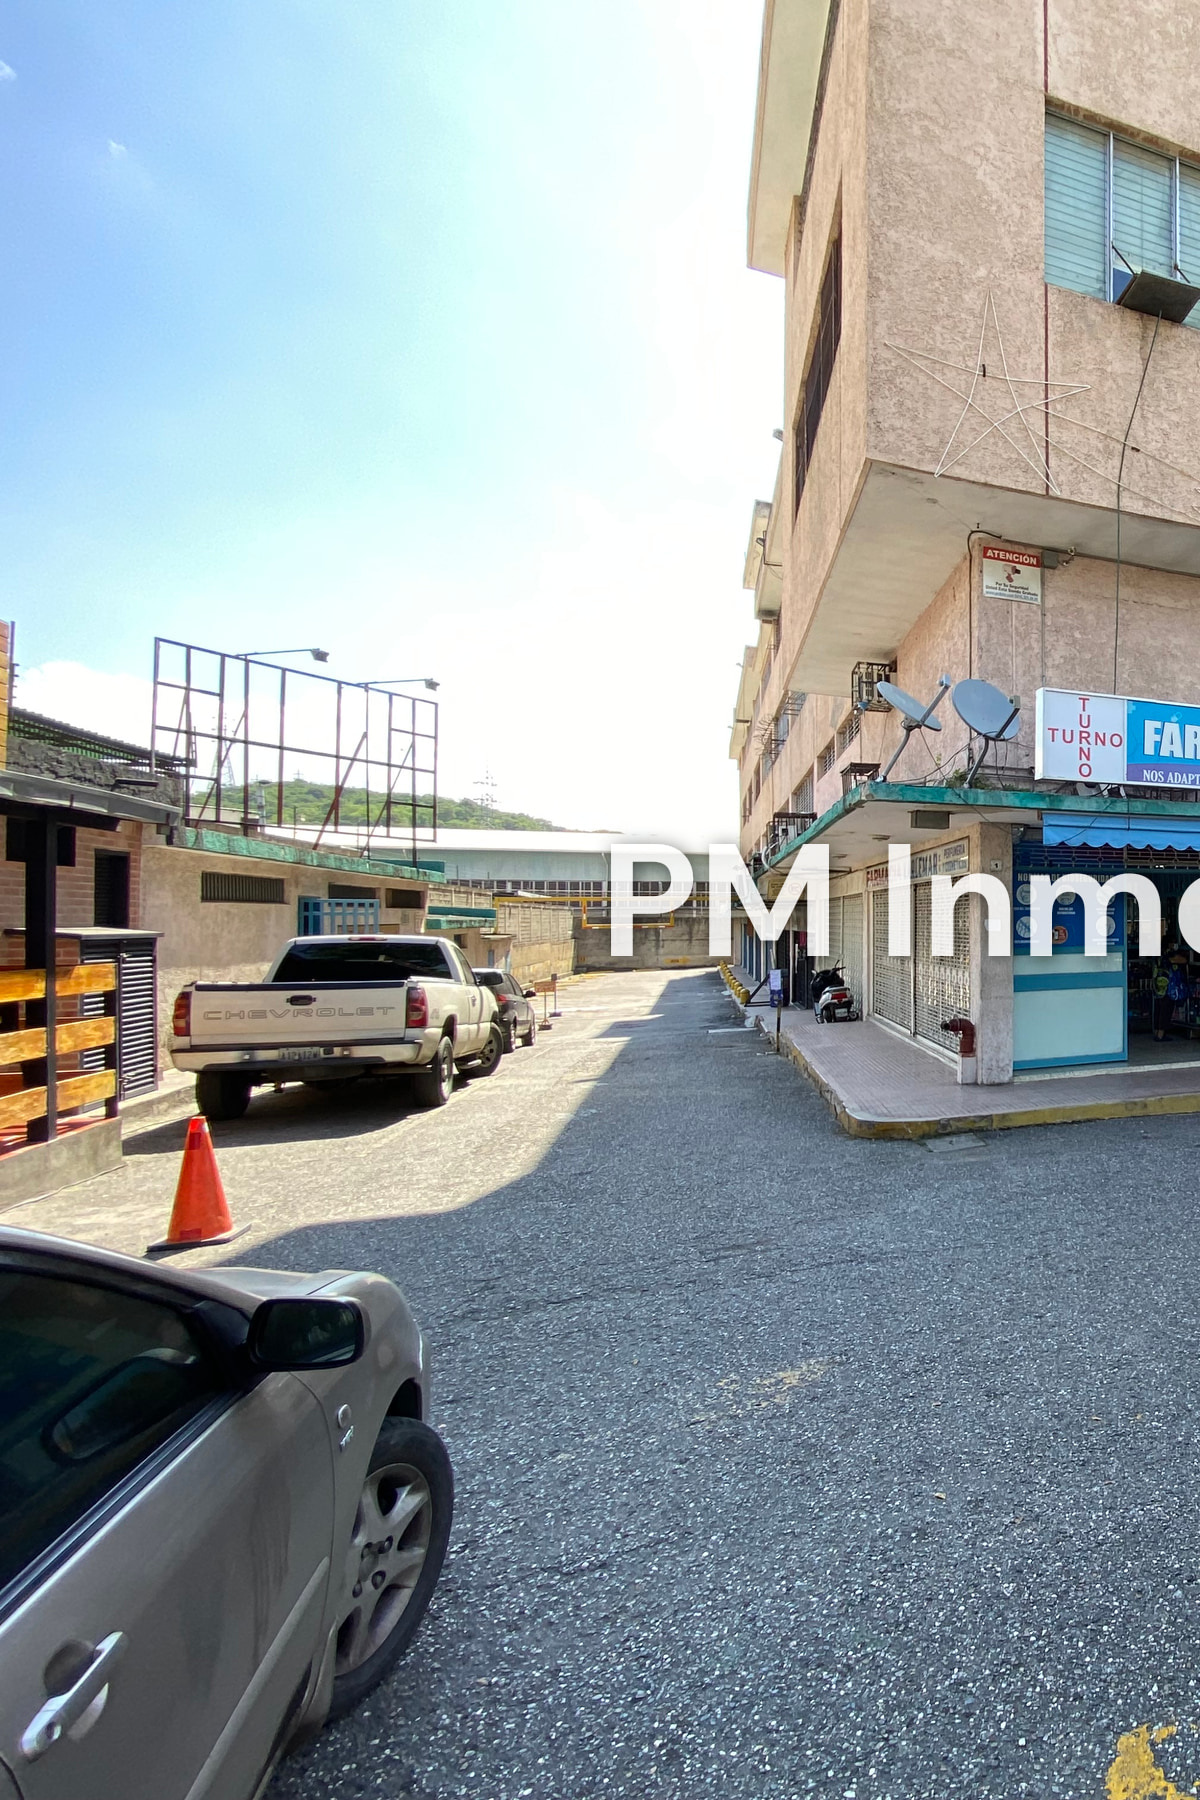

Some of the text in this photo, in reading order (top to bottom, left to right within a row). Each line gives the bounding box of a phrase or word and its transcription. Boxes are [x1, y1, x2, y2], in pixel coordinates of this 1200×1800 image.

[986, 549, 1037, 565] ATENCIÓN
[1048, 727, 1123, 748] TURNO
[1078, 697, 1092, 778] TURNO
[1143, 769, 1165, 783] NOS
[203, 1006, 396, 1021] CHEVROLET
